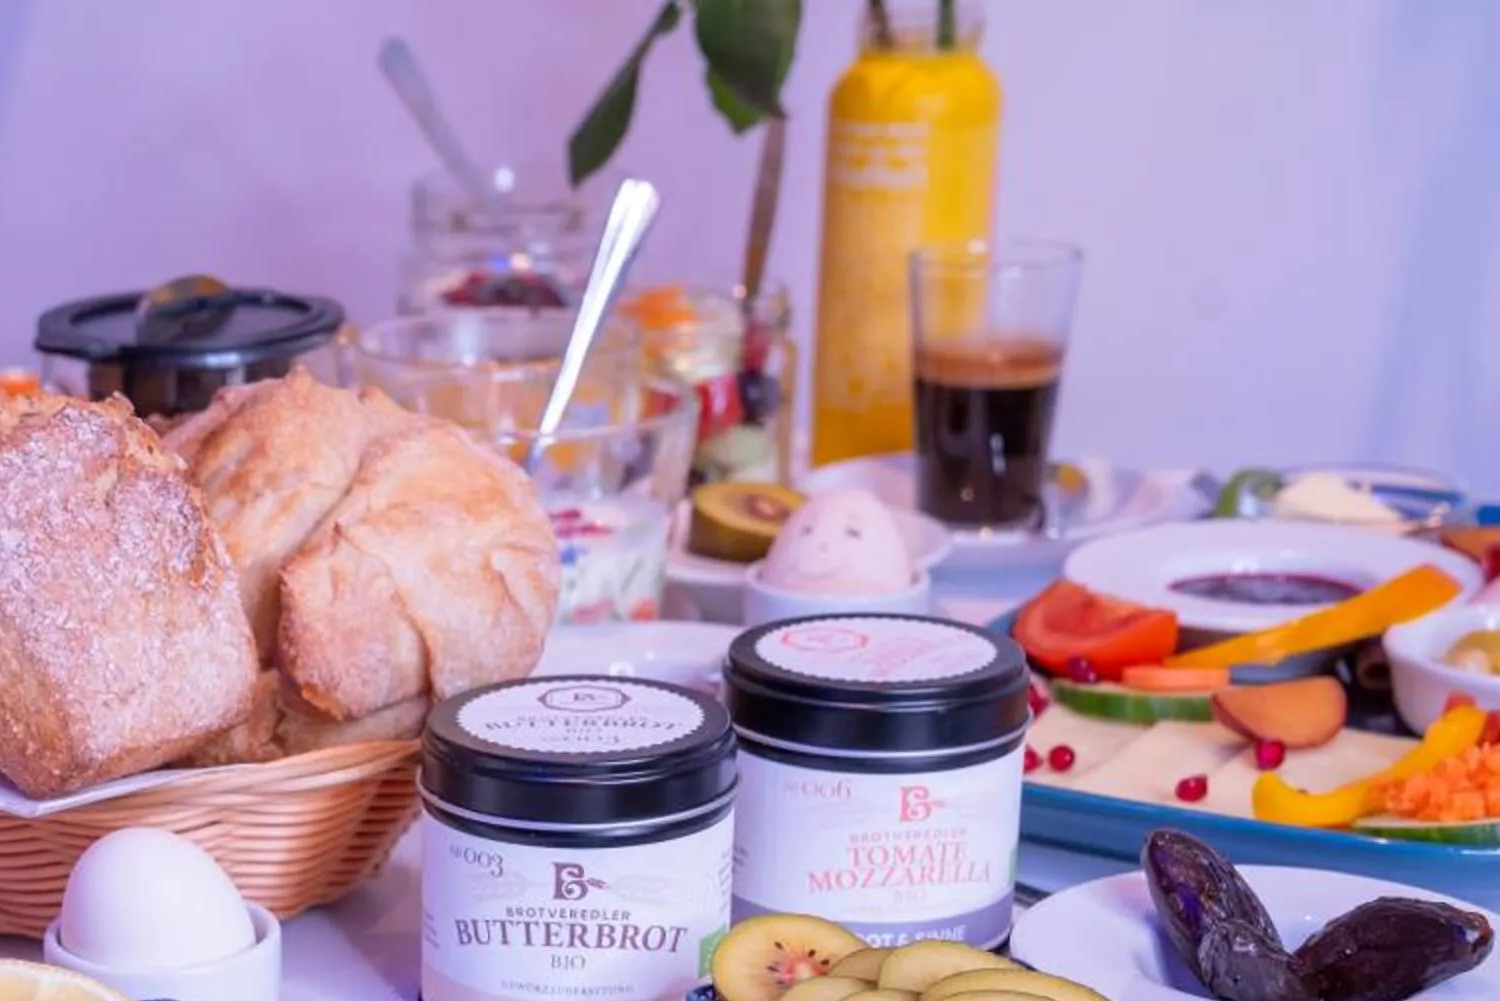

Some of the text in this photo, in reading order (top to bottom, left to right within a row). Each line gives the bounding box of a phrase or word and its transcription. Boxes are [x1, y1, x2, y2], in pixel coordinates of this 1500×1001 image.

[505, 906, 632, 922] BROTVEREDLER
[454, 918, 688, 954] BUTTERBROT
[550, 953, 587, 971] BIO
